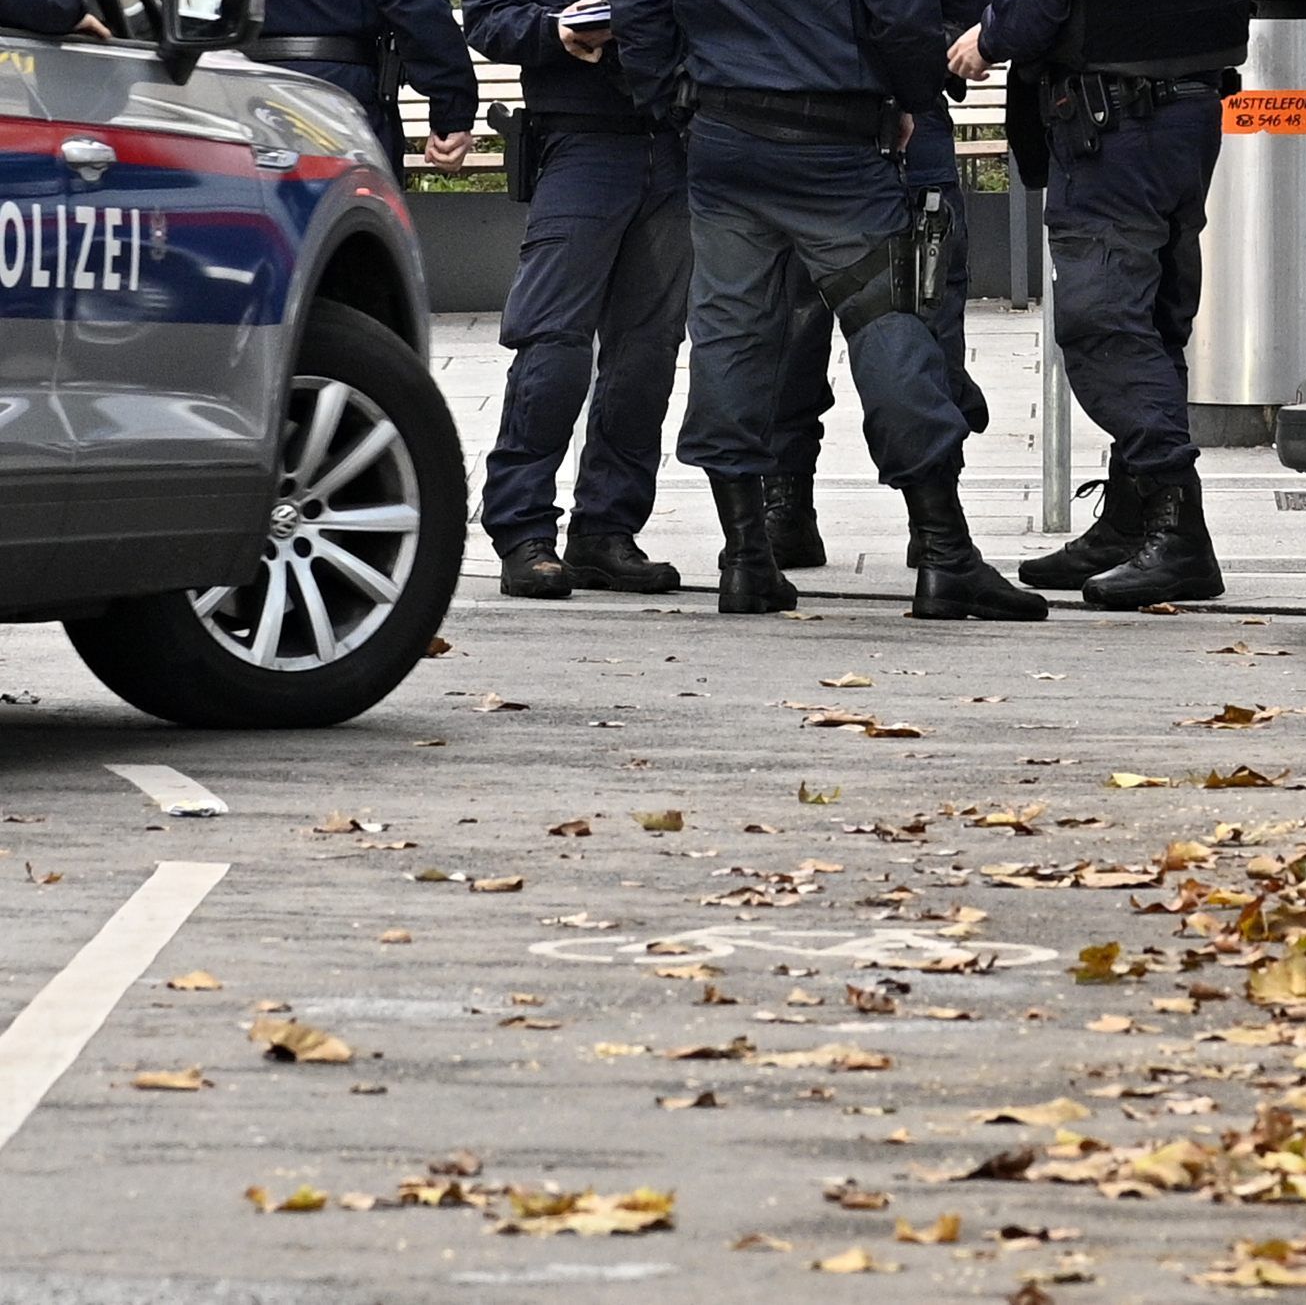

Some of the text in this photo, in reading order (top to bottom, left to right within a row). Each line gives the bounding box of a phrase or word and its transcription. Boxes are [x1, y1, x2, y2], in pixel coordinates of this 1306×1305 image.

[1258, 114, 1301, 127] 546 48
[0, 200, 141, 291] OLIZEI
